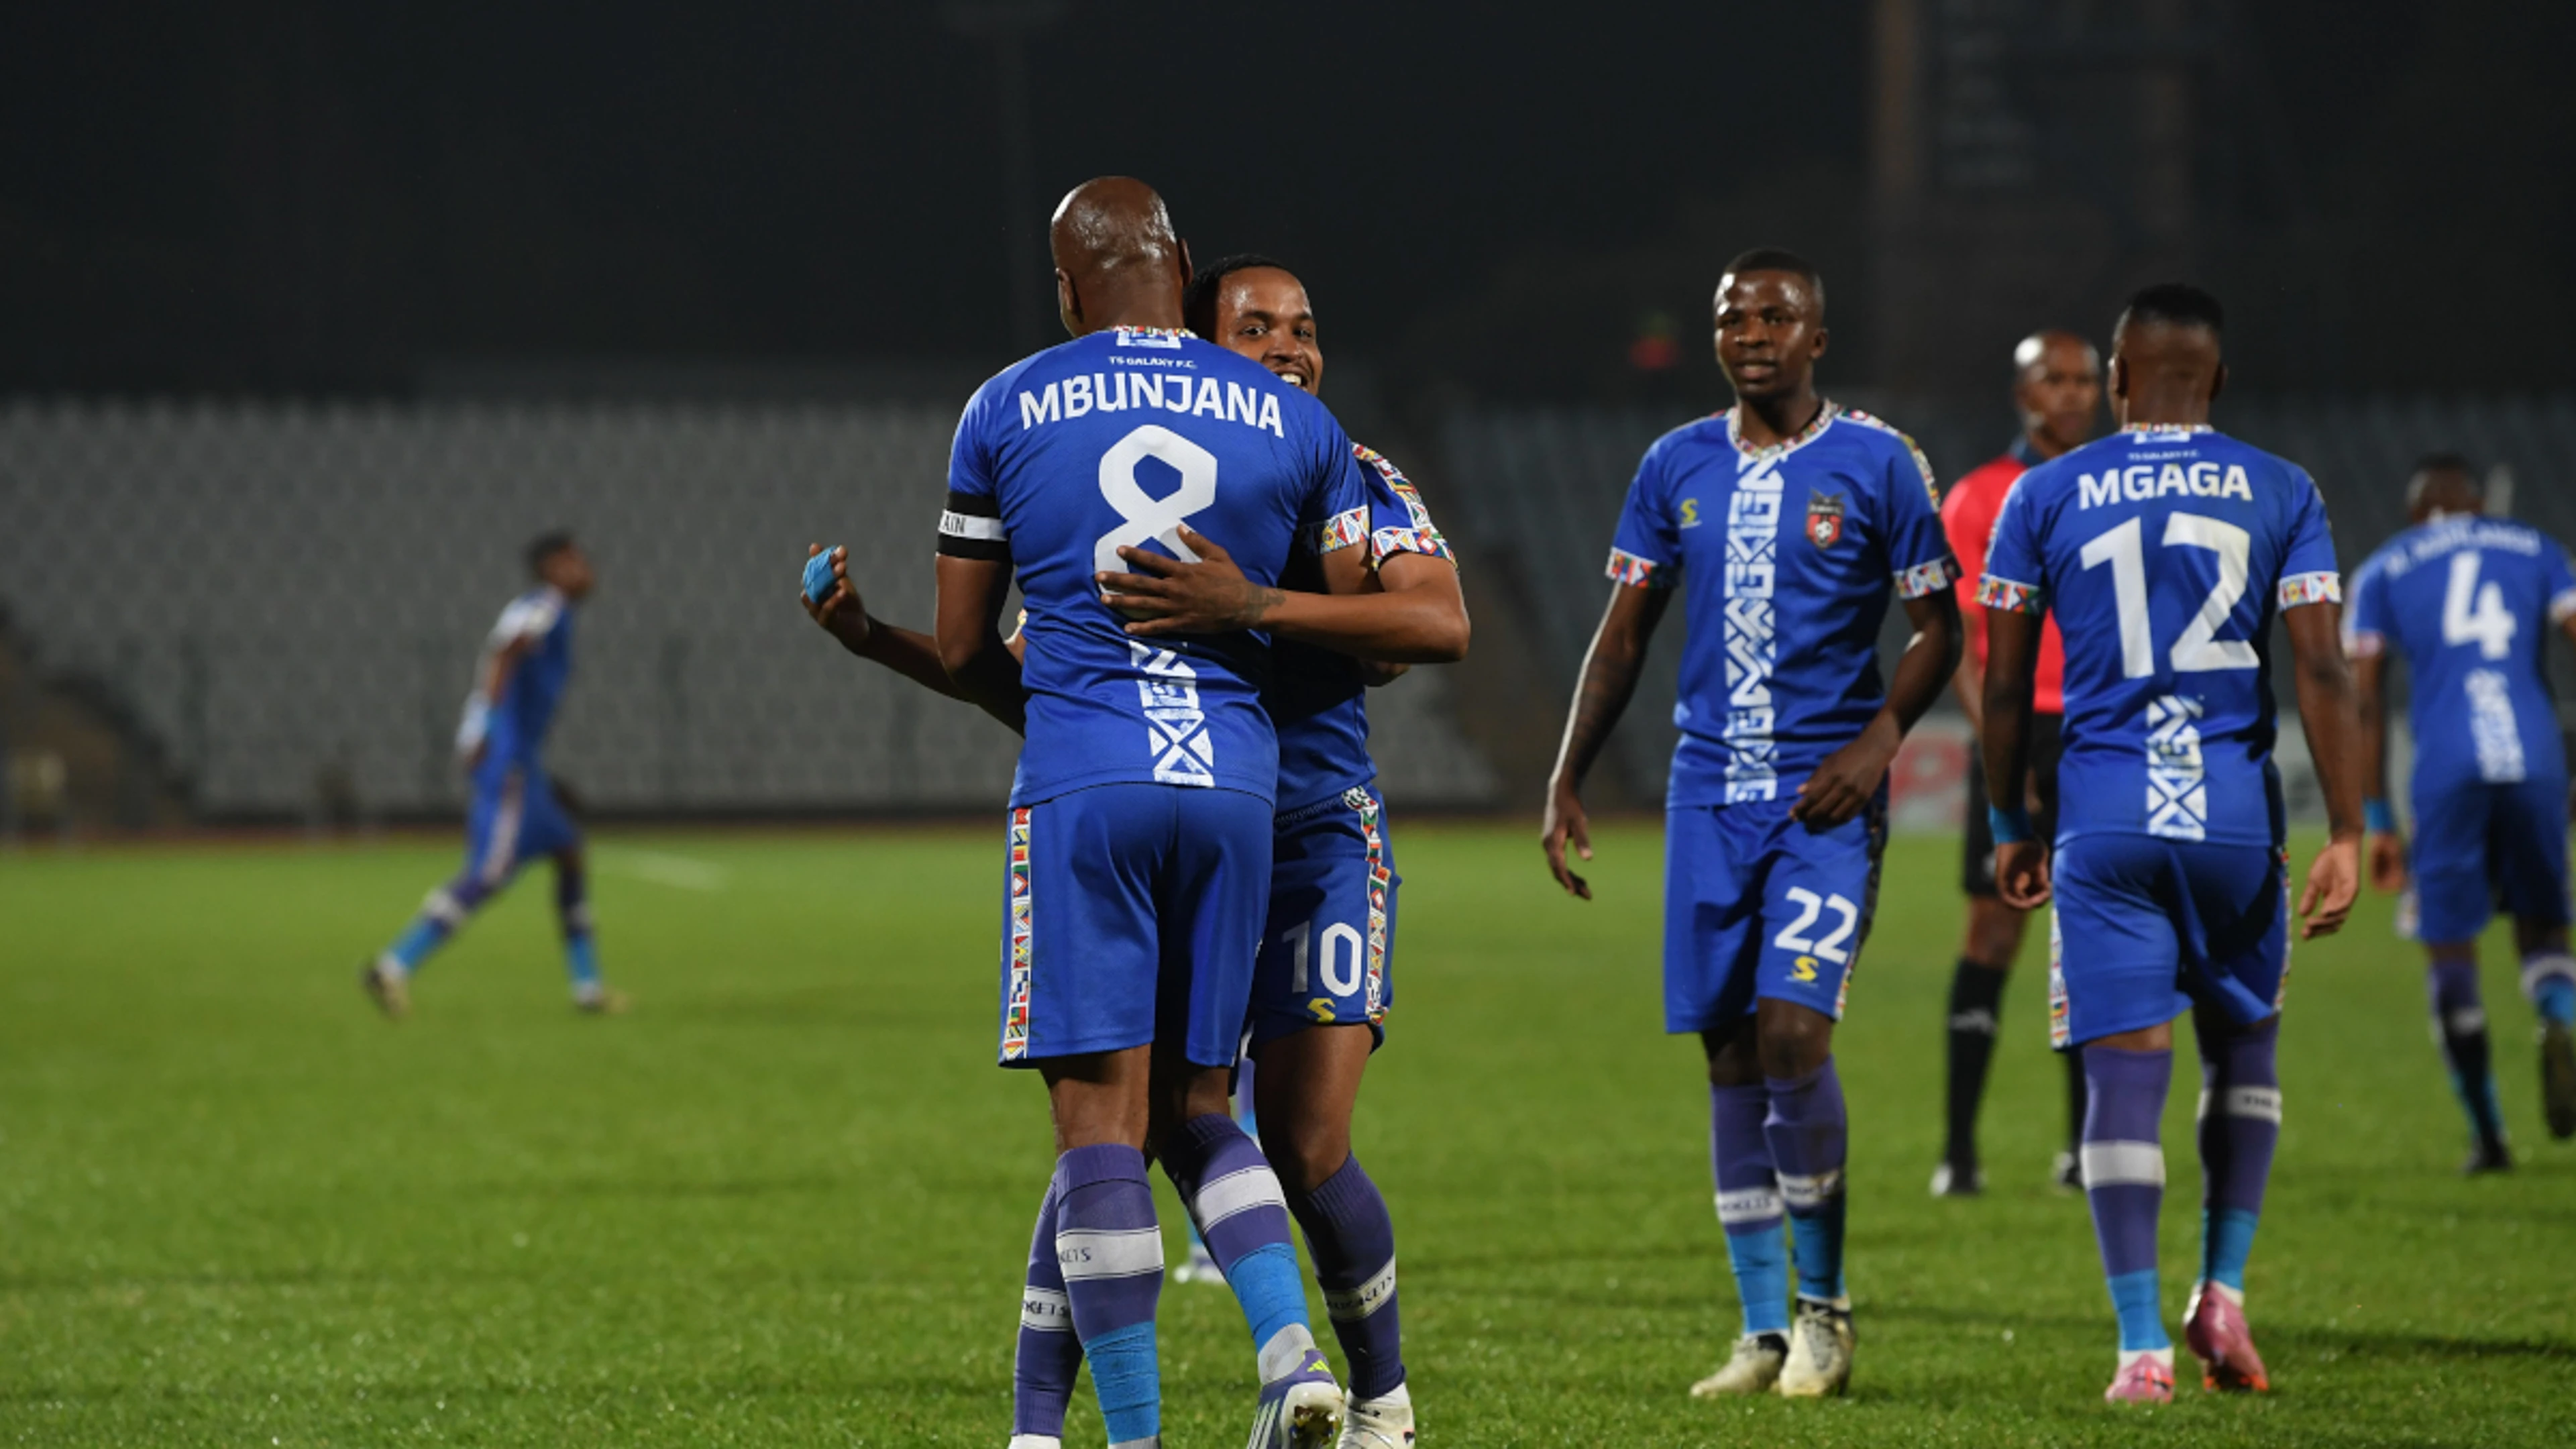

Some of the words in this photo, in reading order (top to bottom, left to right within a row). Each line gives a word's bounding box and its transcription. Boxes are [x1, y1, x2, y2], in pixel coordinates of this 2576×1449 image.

[1109, 356, 1124, 365] TS
[1127, 357, 1174, 367] GALAXY
[1019, 372, 1284, 439] MBUNJANA
[1094, 424, 1218, 619] 8
[2078, 462, 2253, 511] MGAGA
[2080, 511, 2260, 679] 12
[2443, 551, 2517, 661] 4
[1282, 920, 1362, 997] 10
[1774, 885, 1858, 964] 22
